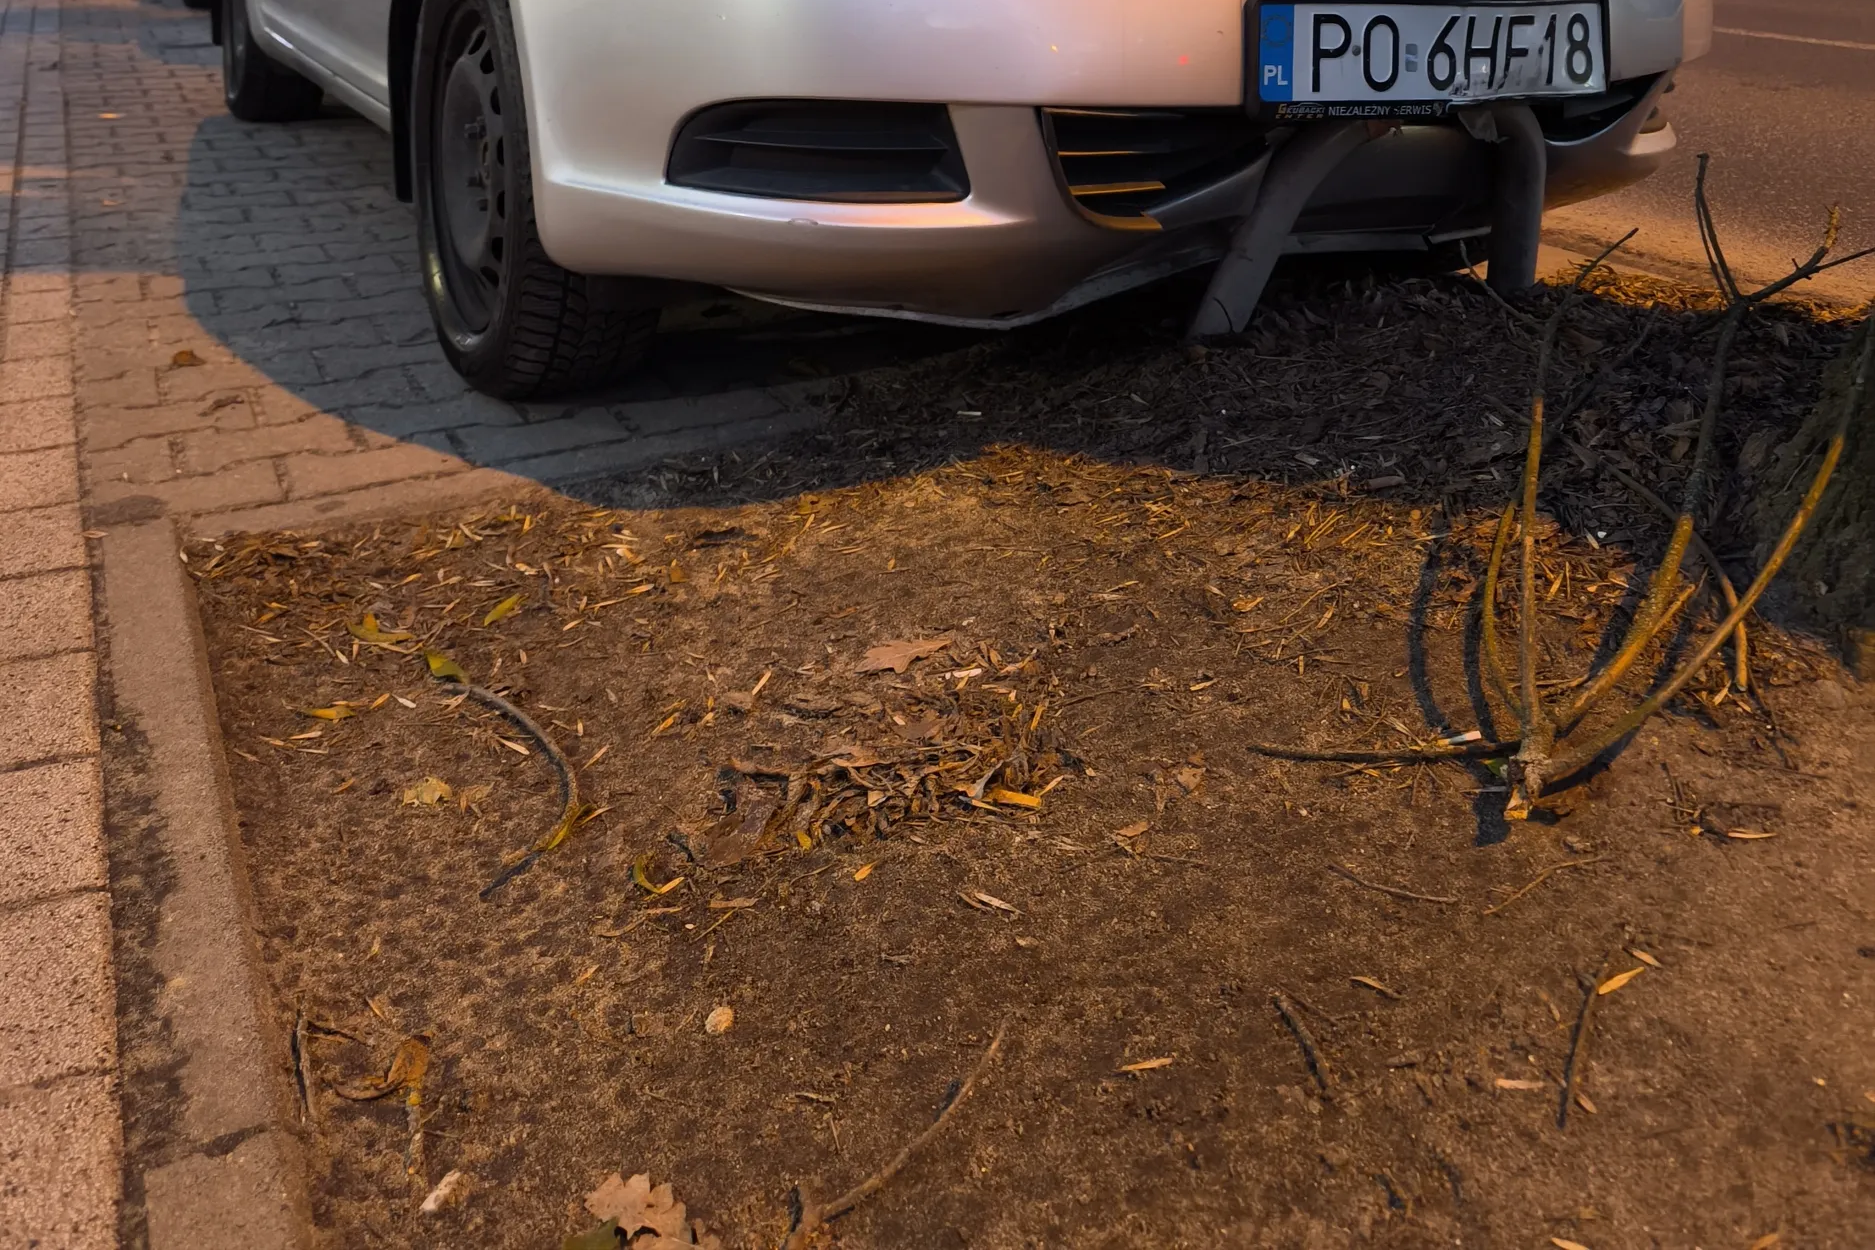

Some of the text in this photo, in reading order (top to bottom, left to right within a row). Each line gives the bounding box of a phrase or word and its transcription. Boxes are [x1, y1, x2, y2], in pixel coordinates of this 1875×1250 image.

[1263, 65, 1289, 86] PL
[1311, 12, 1594, 93] PO 6HF18
